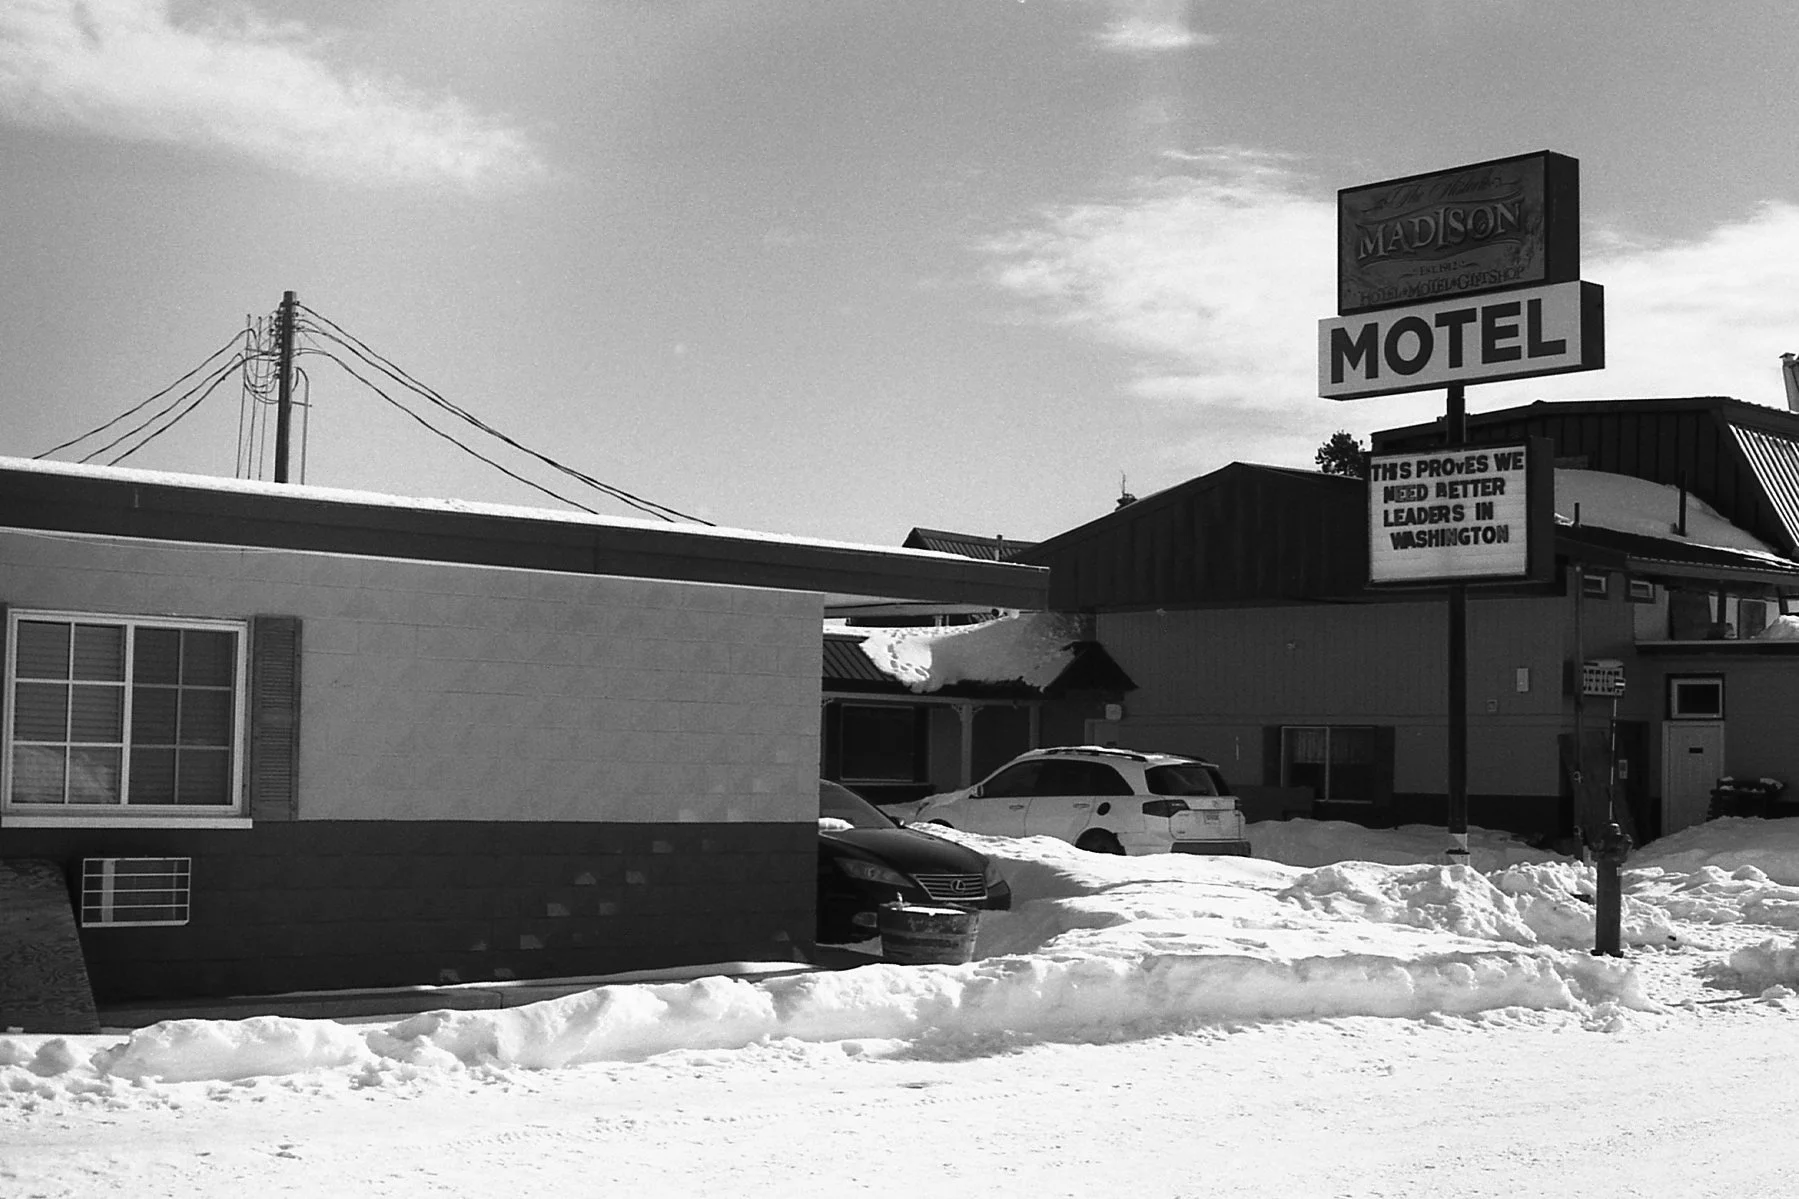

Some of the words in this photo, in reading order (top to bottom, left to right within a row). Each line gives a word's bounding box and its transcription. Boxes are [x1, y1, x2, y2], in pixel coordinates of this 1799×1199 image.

[1356, 200, 1524, 261] MADISON
[1360, 286, 1403, 307] HOTEL
[1407, 278, 1453, 298] MOTEL
[1331, 298, 1567, 385] MOTEL
[1371, 461, 1412, 482] THIS
[1494, 451, 1525, 472] WE
[1383, 483, 1429, 504] NEED
[1435, 477, 1506, 499] BETTER
[1383, 504, 1465, 527] LEADERS
[1475, 501, 1494, 521] IN
[1390, 524, 1510, 551] WASHINGTON
